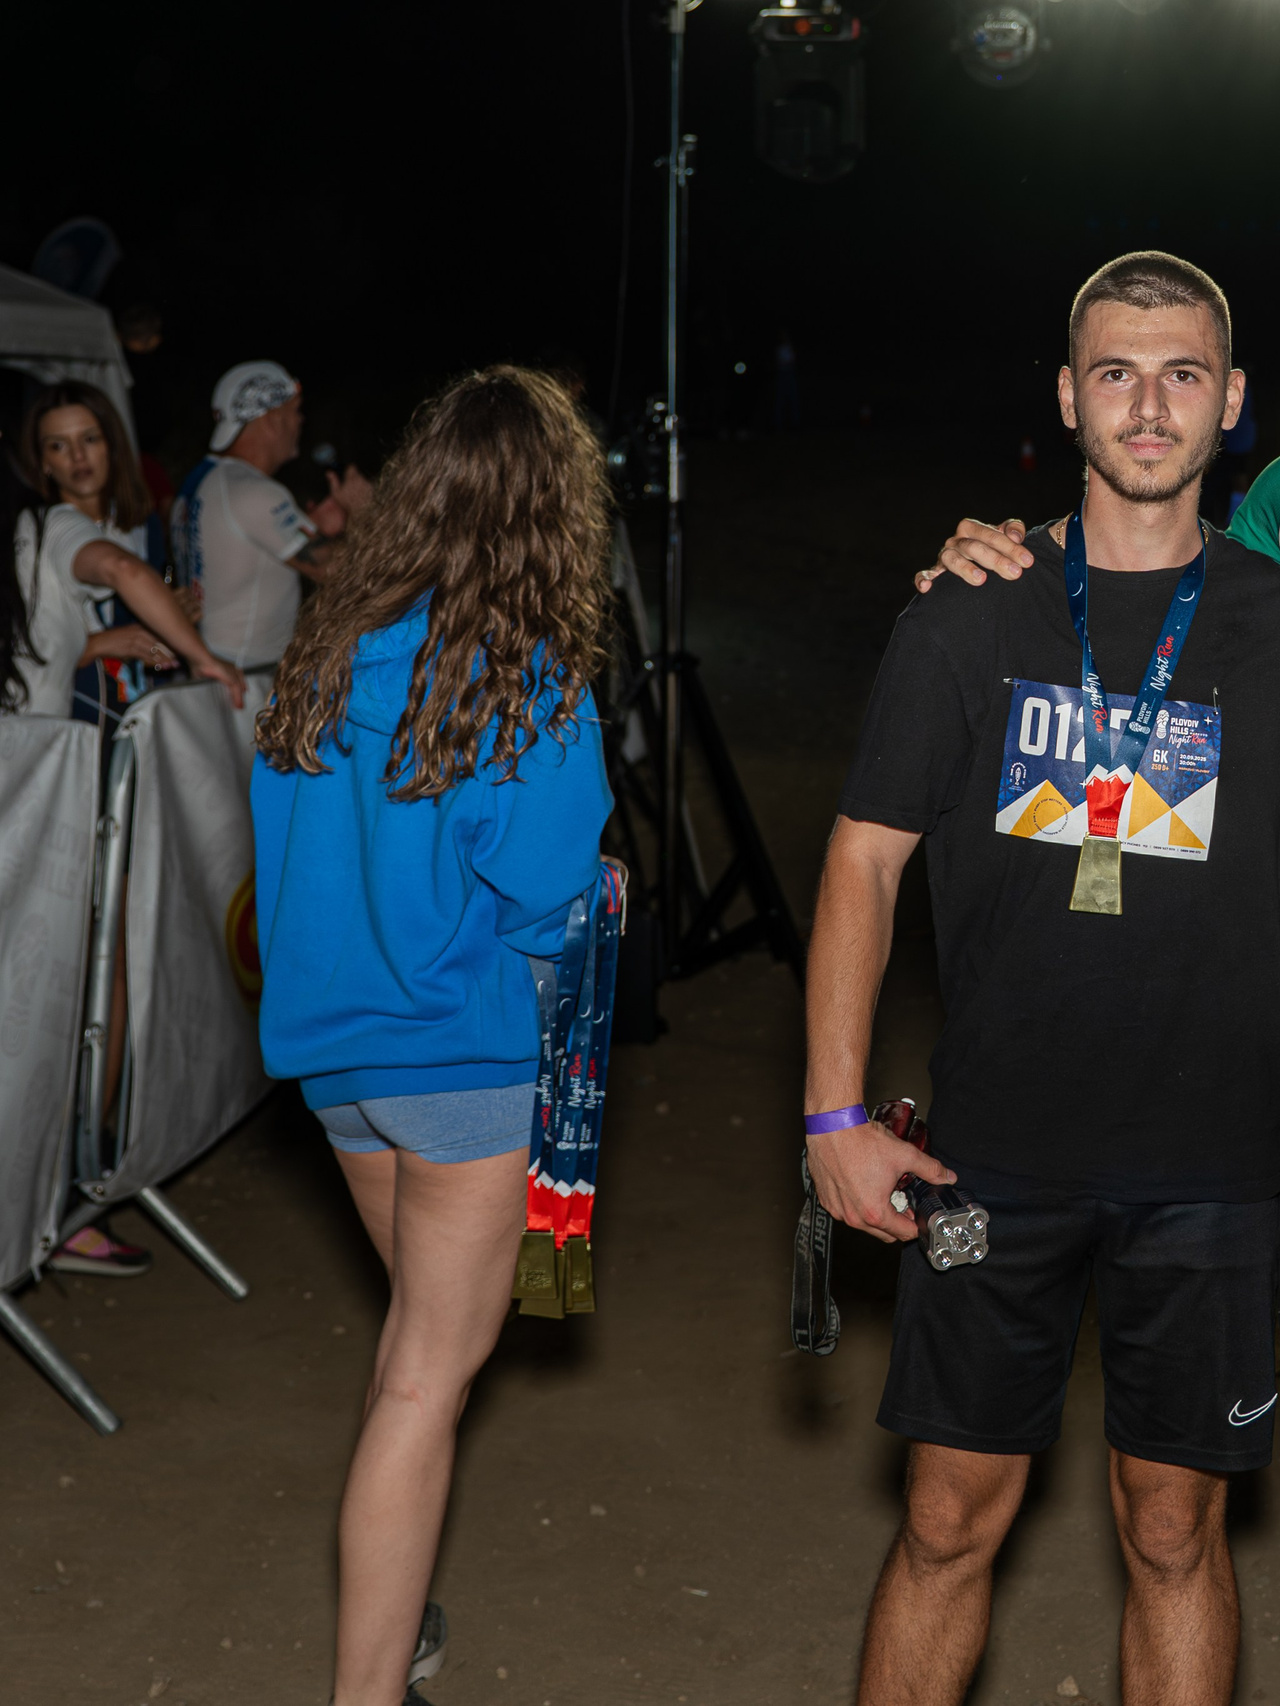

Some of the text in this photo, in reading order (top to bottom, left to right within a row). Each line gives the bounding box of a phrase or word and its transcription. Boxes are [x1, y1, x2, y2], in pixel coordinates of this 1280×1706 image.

[1150, 634, 1175, 692] Night Run
[1082, 672, 1108, 734] Night Run
[1170, 717, 1200, 728] PLOVDIV
[1169, 725, 1189, 736] HILLS
[1168, 733, 1192, 749] Night
[1191, 733, 1208, 745] Run
[1153, 749, 1169, 764] 6K
